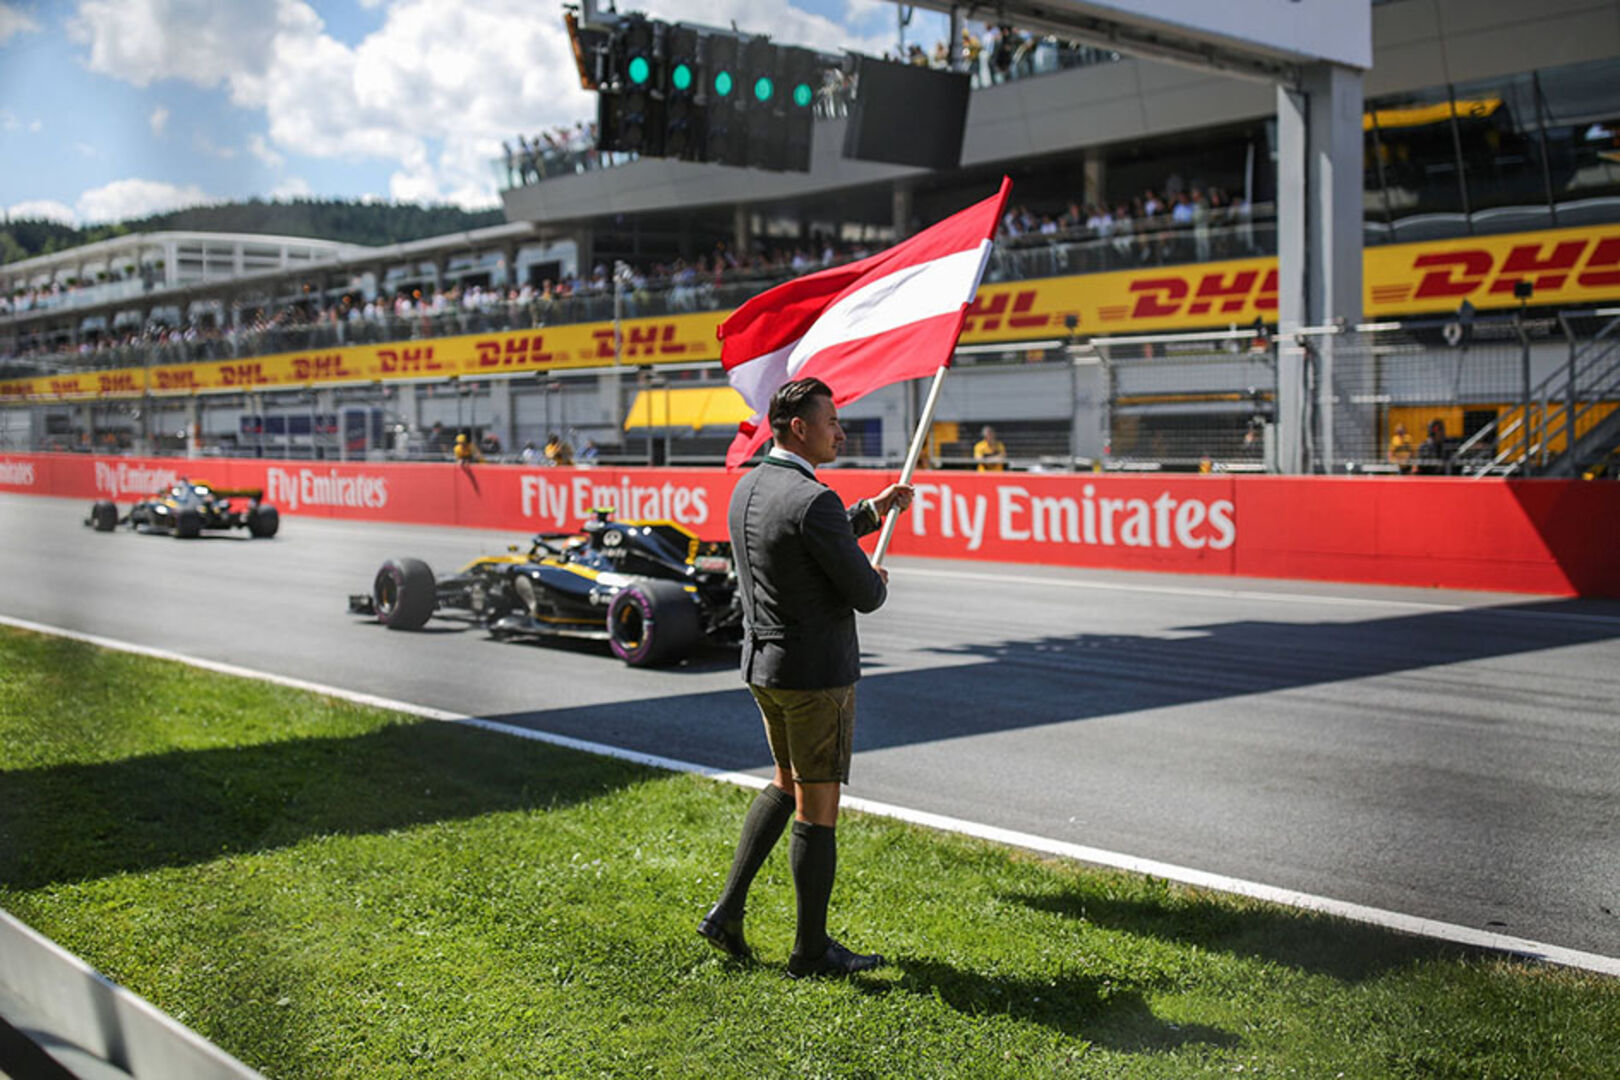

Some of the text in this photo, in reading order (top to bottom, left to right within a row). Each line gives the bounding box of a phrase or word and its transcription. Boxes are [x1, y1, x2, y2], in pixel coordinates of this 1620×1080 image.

[962, 289, 1049, 333] HL
[475, 336, 553, 367] DHL
[591, 324, 687, 358] DHL
[219, 364, 268, 385] DHL
[291, 354, 349, 380] DHL
[377, 346, 442, 373] DHL
[156, 370, 200, 389] DHL
[96, 461, 118, 498] Fly
[266, 467, 388, 510] Fly Emirates
[521, 475, 709, 529] Fly Emirates
[911, 483, 1236, 550] Fly Emirates
